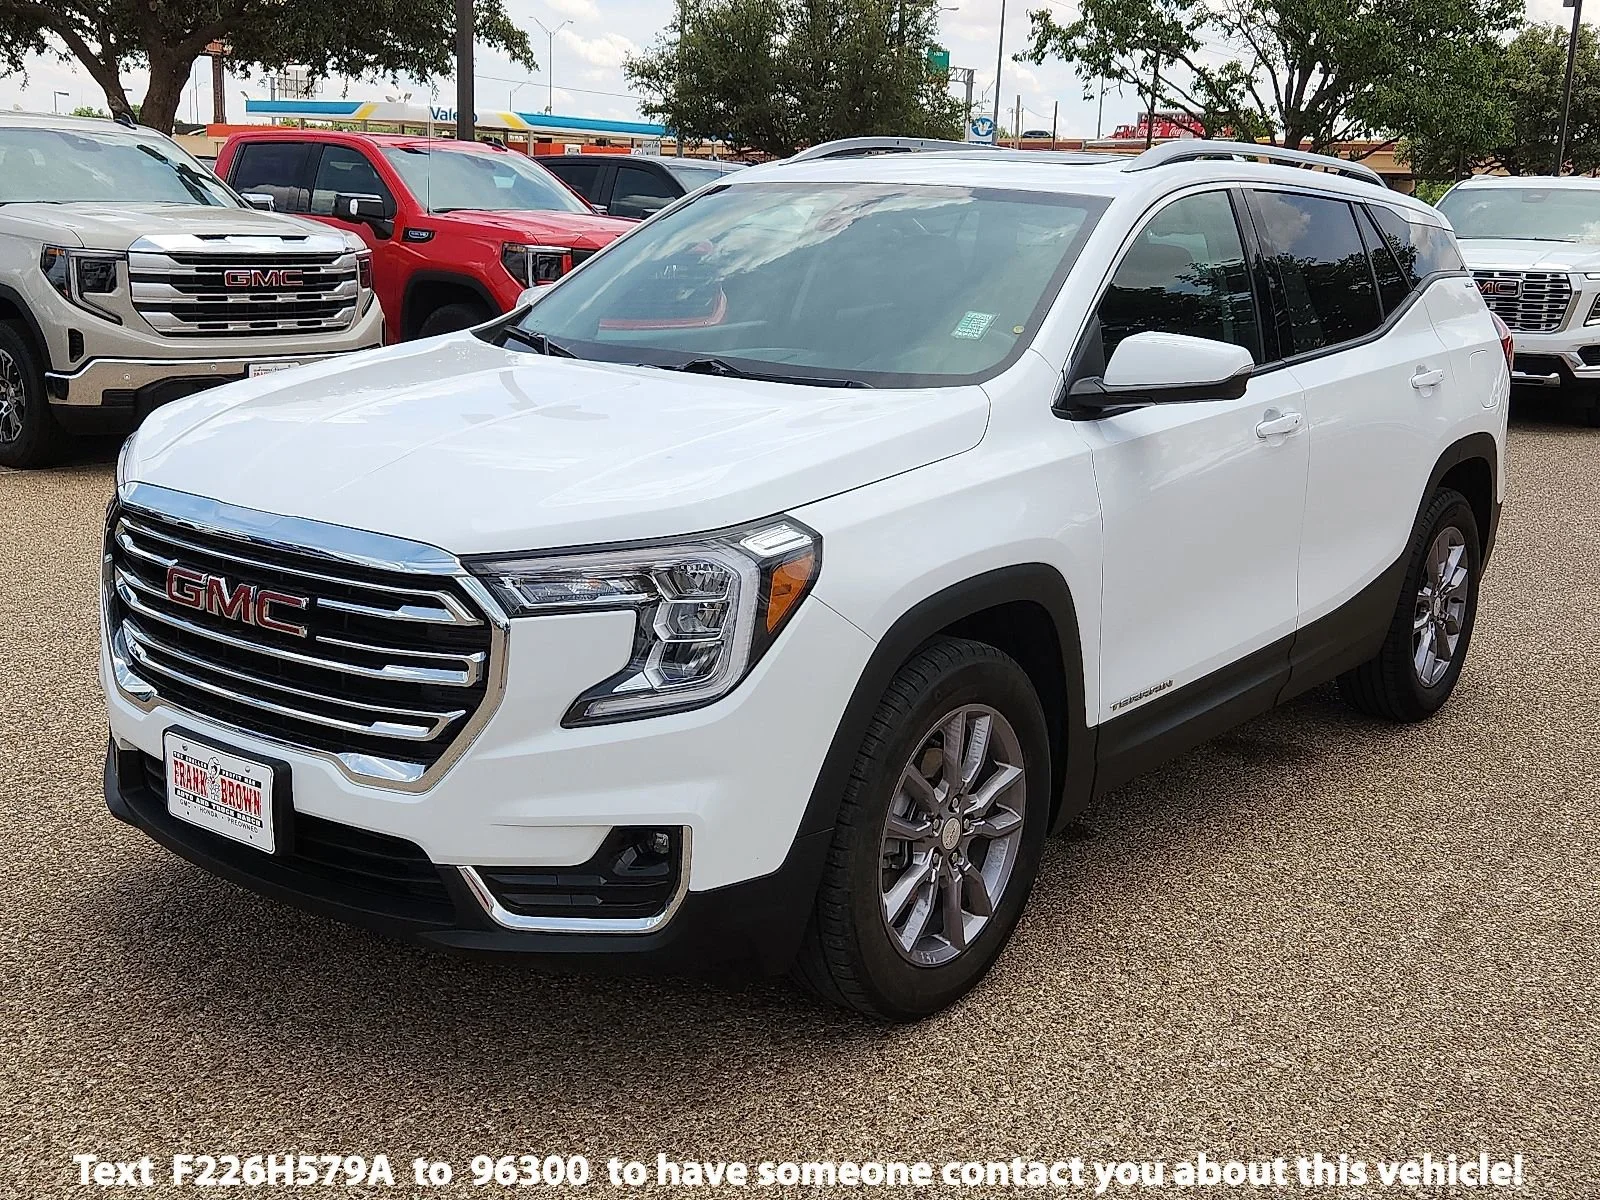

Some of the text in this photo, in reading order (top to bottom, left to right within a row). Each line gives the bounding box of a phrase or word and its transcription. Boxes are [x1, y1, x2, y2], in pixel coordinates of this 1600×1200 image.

[430, 106, 478, 123] Valeo
[224, 269, 304, 287] GMC
[1476, 281, 1516, 294] MC
[166, 565, 309, 639] GMC
[1110, 679, 1174, 711] TERRAIN
[174, 759, 261, 817] FRANK BROWN
[176, 789, 260, 826] AUTO AND TRUCK RANCH
[200, 807, 218, 818] HONDA
[227, 817, 258, 833] PREOWNED
